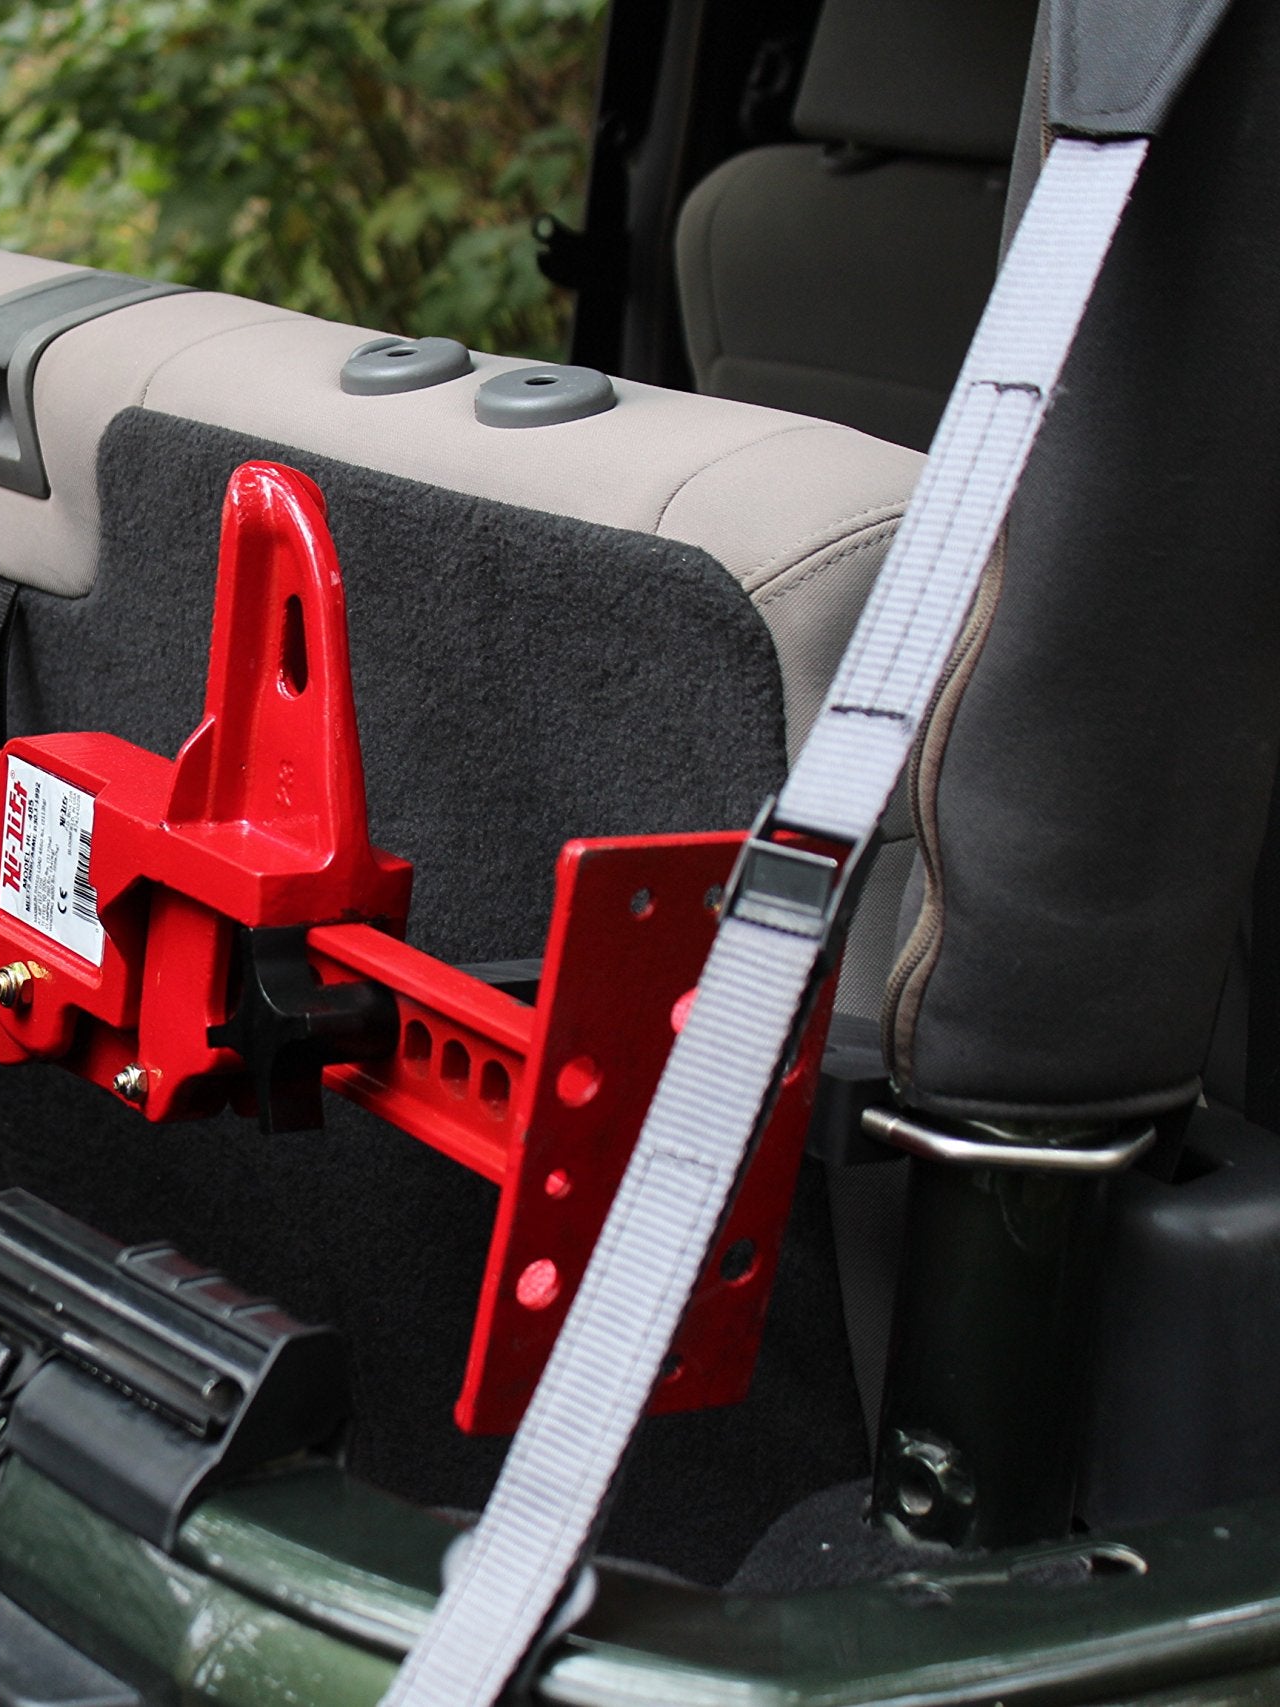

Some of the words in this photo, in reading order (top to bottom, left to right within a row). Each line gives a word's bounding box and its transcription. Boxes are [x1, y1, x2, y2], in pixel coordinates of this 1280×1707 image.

[3, 781, 27, 892] Hi-Lift
[25, 831, 31, 847] HL
[22, 851, 30, 890] MODEL
